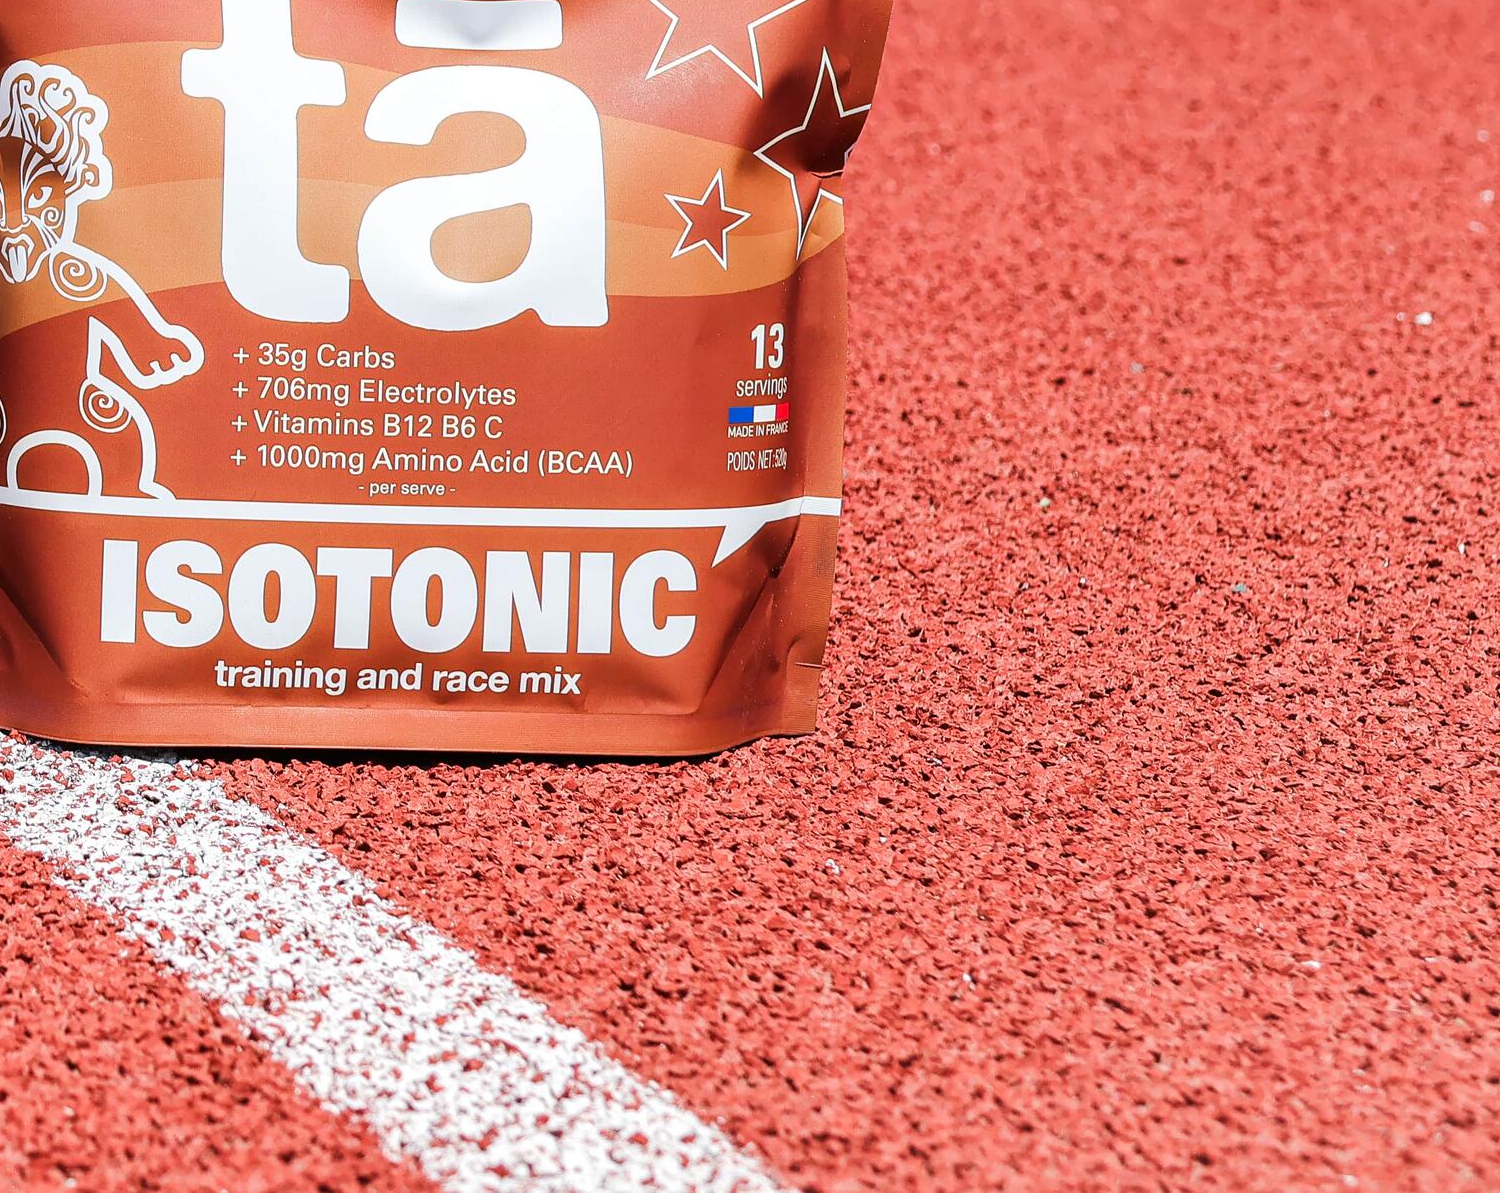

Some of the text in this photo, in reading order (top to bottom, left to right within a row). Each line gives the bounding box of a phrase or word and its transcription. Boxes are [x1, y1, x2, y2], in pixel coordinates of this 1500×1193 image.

[257, 342, 308, 372] 35g
[315, 343, 396, 370] Carbs
[750, 322, 785, 371] 13
[256, 376, 350, 407] 706mg
[358, 379, 517, 410] Electrolytes
[735, 373, 788, 400] servings
[253, 409, 375, 437] Vitamins
[382, 412, 433, 439] B12
[441, 414, 477, 439] B6
[483, 415, 504, 440] C
[727, 420, 789, 438] MADE IN FRANCE
[256, 444, 365, 475] 1000mg
[370, 447, 464, 473] Amino
[469, 448, 530, 474] Acid
[537, 448, 634, 478] (BCAA)
[727, 450, 756, 472] POIDS
[368, 483, 396, 497] per
[401, 482, 446, 497] serve
[99, 538, 699, 658] ISOTONIC
[213, 658, 583, 696] training and race mix
